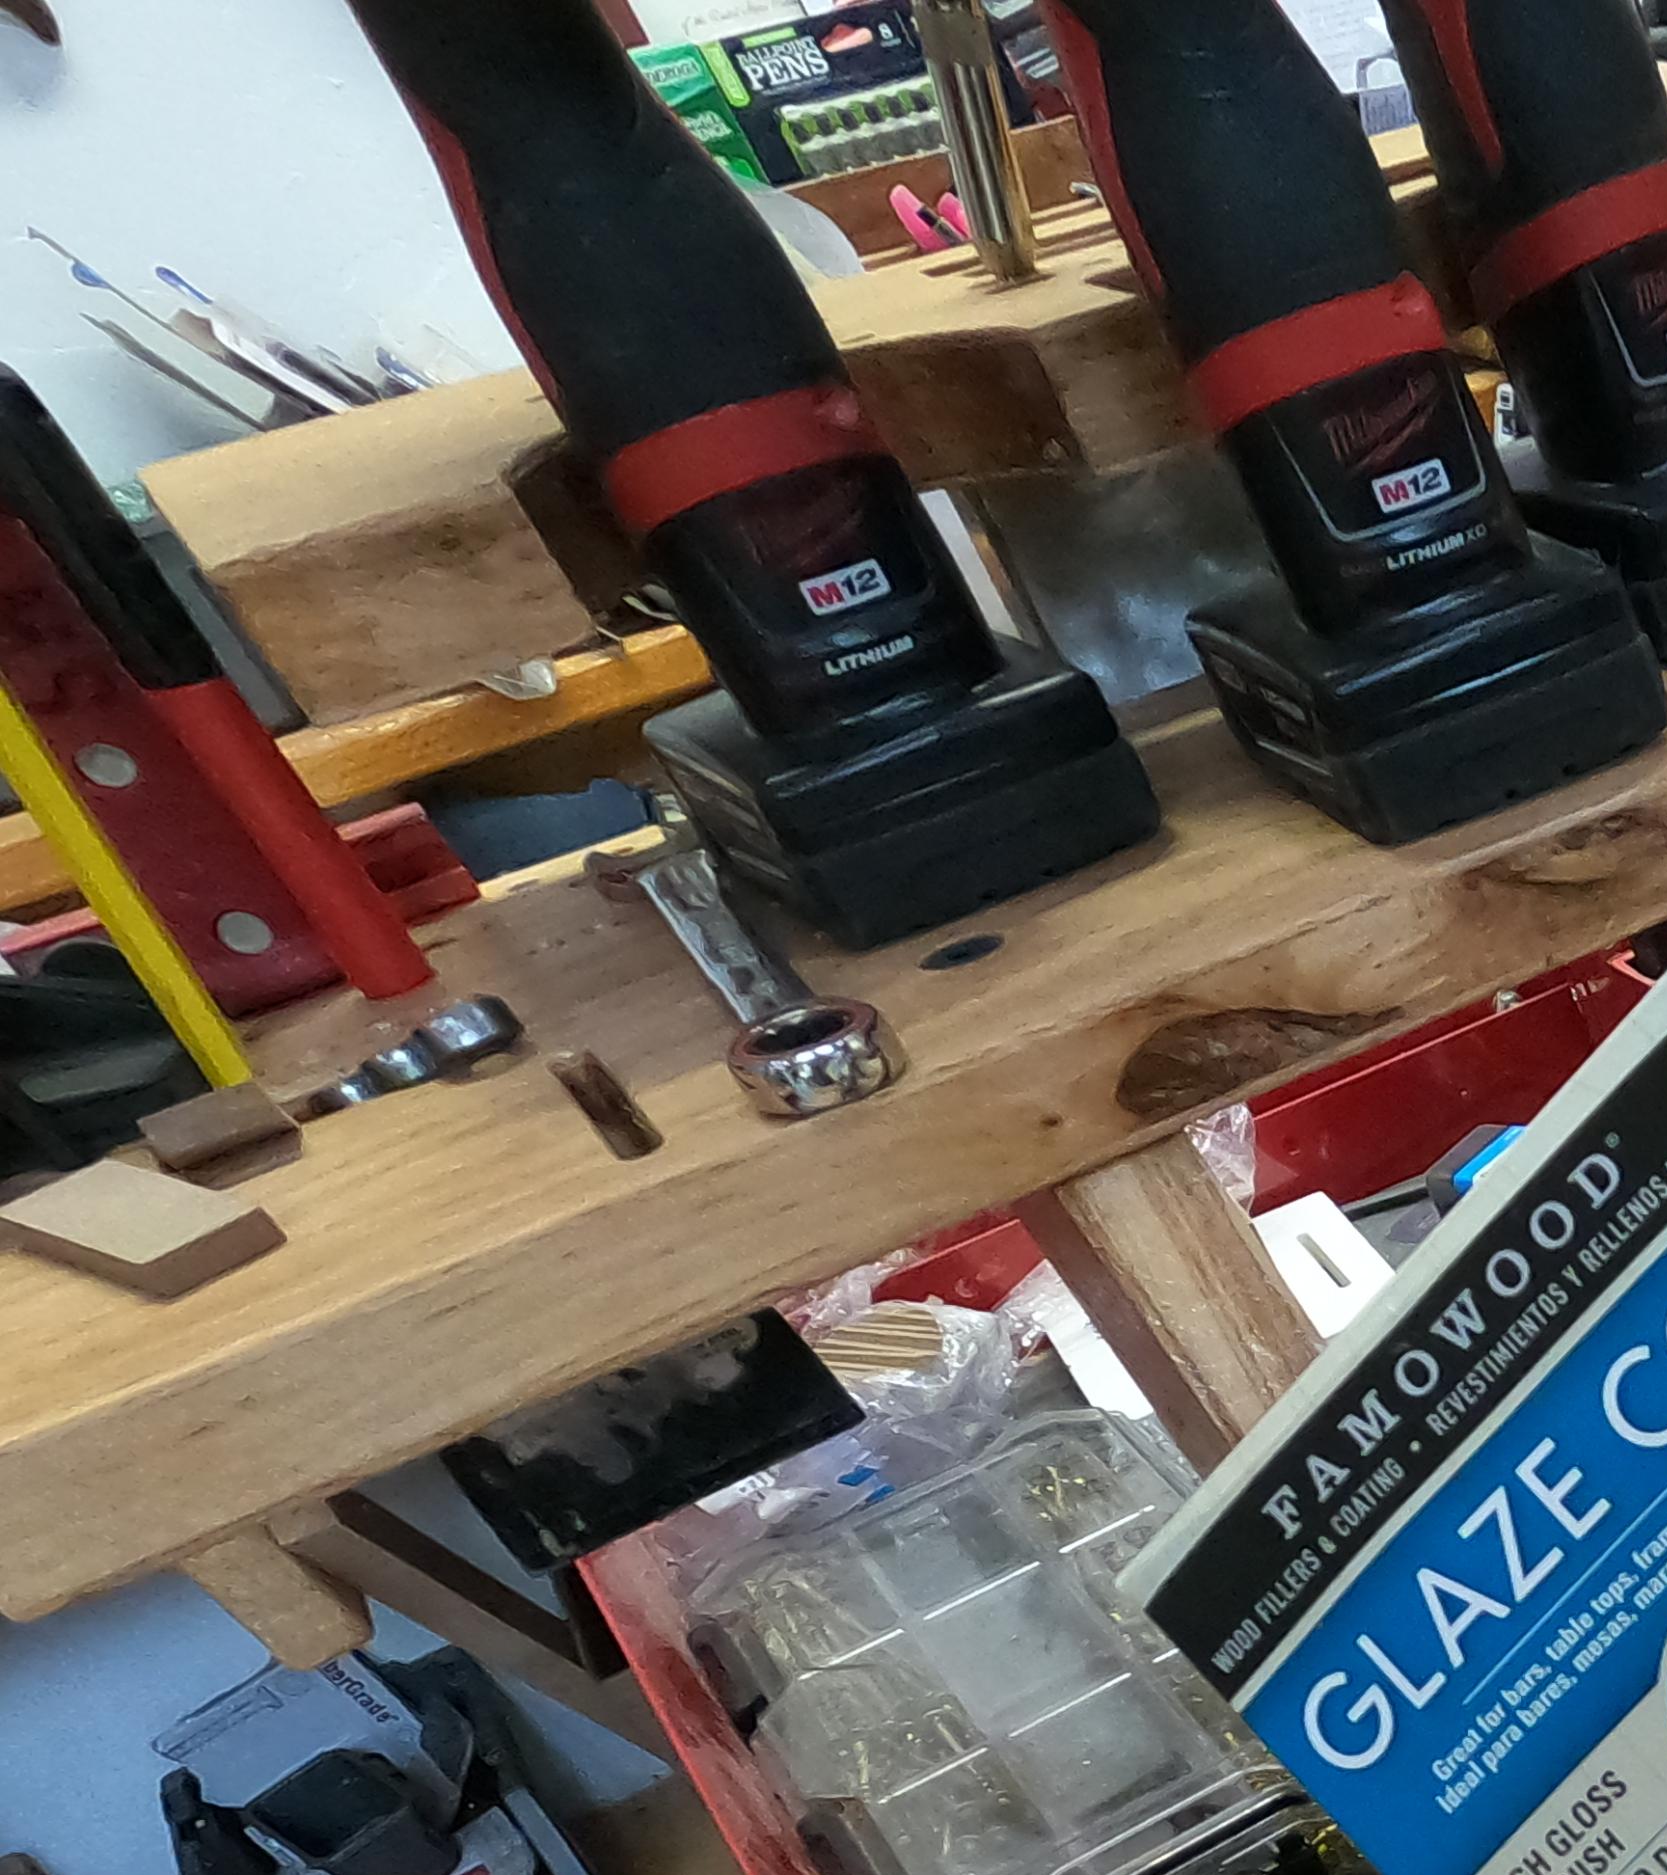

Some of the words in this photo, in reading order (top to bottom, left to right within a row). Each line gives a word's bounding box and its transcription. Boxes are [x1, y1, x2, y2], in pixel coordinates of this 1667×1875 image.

[735, 35, 821, 67] BALLPOINT
[740, 47, 830, 91] PENS
[1378, 466, 1443, 506] M12
[806, 567, 881, 608] M12
[823, 634, 915, 677] LITHIUM
[1262, 1153, 1619, 1538] FAMOWOOD
[1210, 1618, 1262, 1673] WOOD
[1253, 1547, 1321, 1624] FILLERS
[1317, 1535, 1337, 1554] &
[1330, 1457, 1404, 1537] COATING
[1425, 1282, 1568, 1435] REVESTIMIENTOS
[1560, 1263, 1583, 1287] Y
[1303, 1438, 1609, 1769] GLAZE
[1428, 1724, 1485, 1784] Great
[1474, 1698, 1509, 1735] for
[1499, 1652, 1554, 1710] bars,
[1542, 1606, 1597, 1664] table
[1588, 1563, 1643, 1621] tops,
[1433, 1758, 1487, 1815] Ideal
[1477, 1720, 1529, 1774] para
[1514, 1663, 1580, 1732] bares,
[1569, 1603, 1640, 1677] mesas,
[1544, 1769, 1627, 1857] GLOSS
